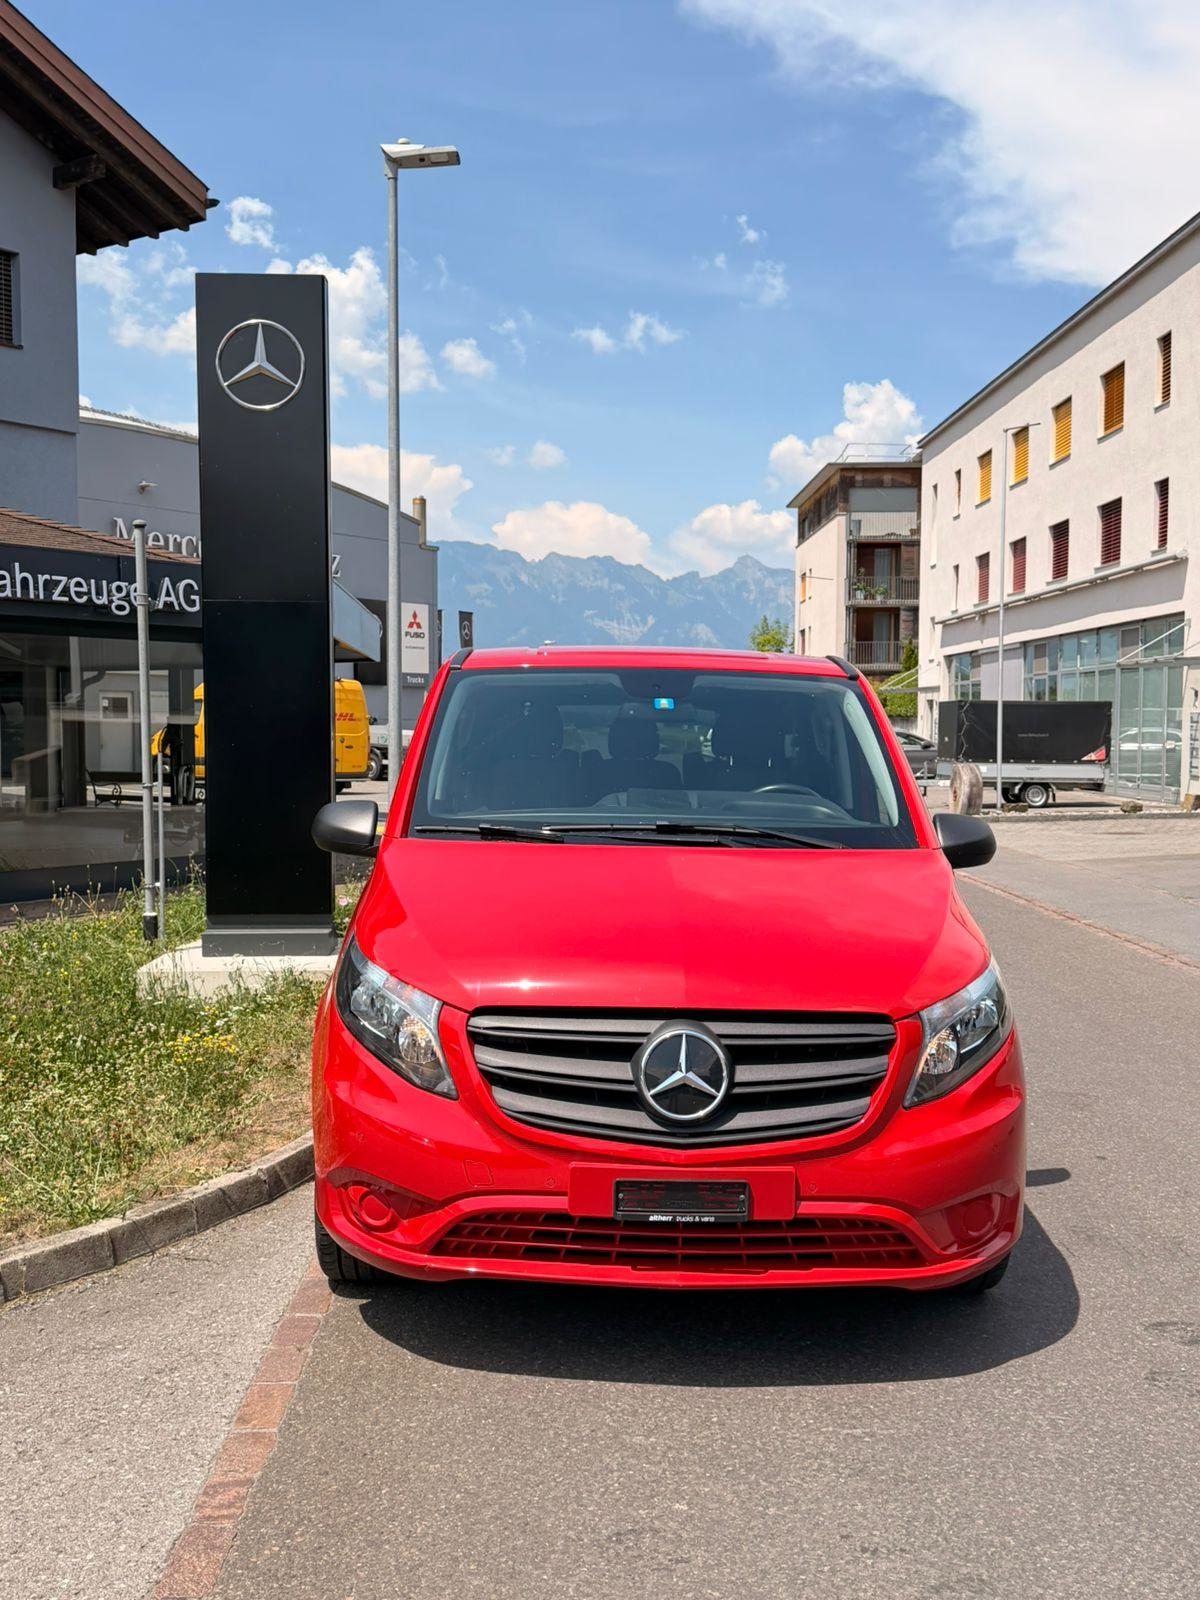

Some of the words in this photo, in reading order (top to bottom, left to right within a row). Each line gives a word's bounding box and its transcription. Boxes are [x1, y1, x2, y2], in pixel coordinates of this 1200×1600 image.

[113, 517, 201, 559] Merc
[158, 576, 201, 613] AG
[404, 631, 425, 639] FUSO
[407, 675, 425, 684] Trucks
[648, 1214, 674, 1222] altherr
[676, 1215, 694, 1223] trucks
[694, 1215, 700, 1223] &
